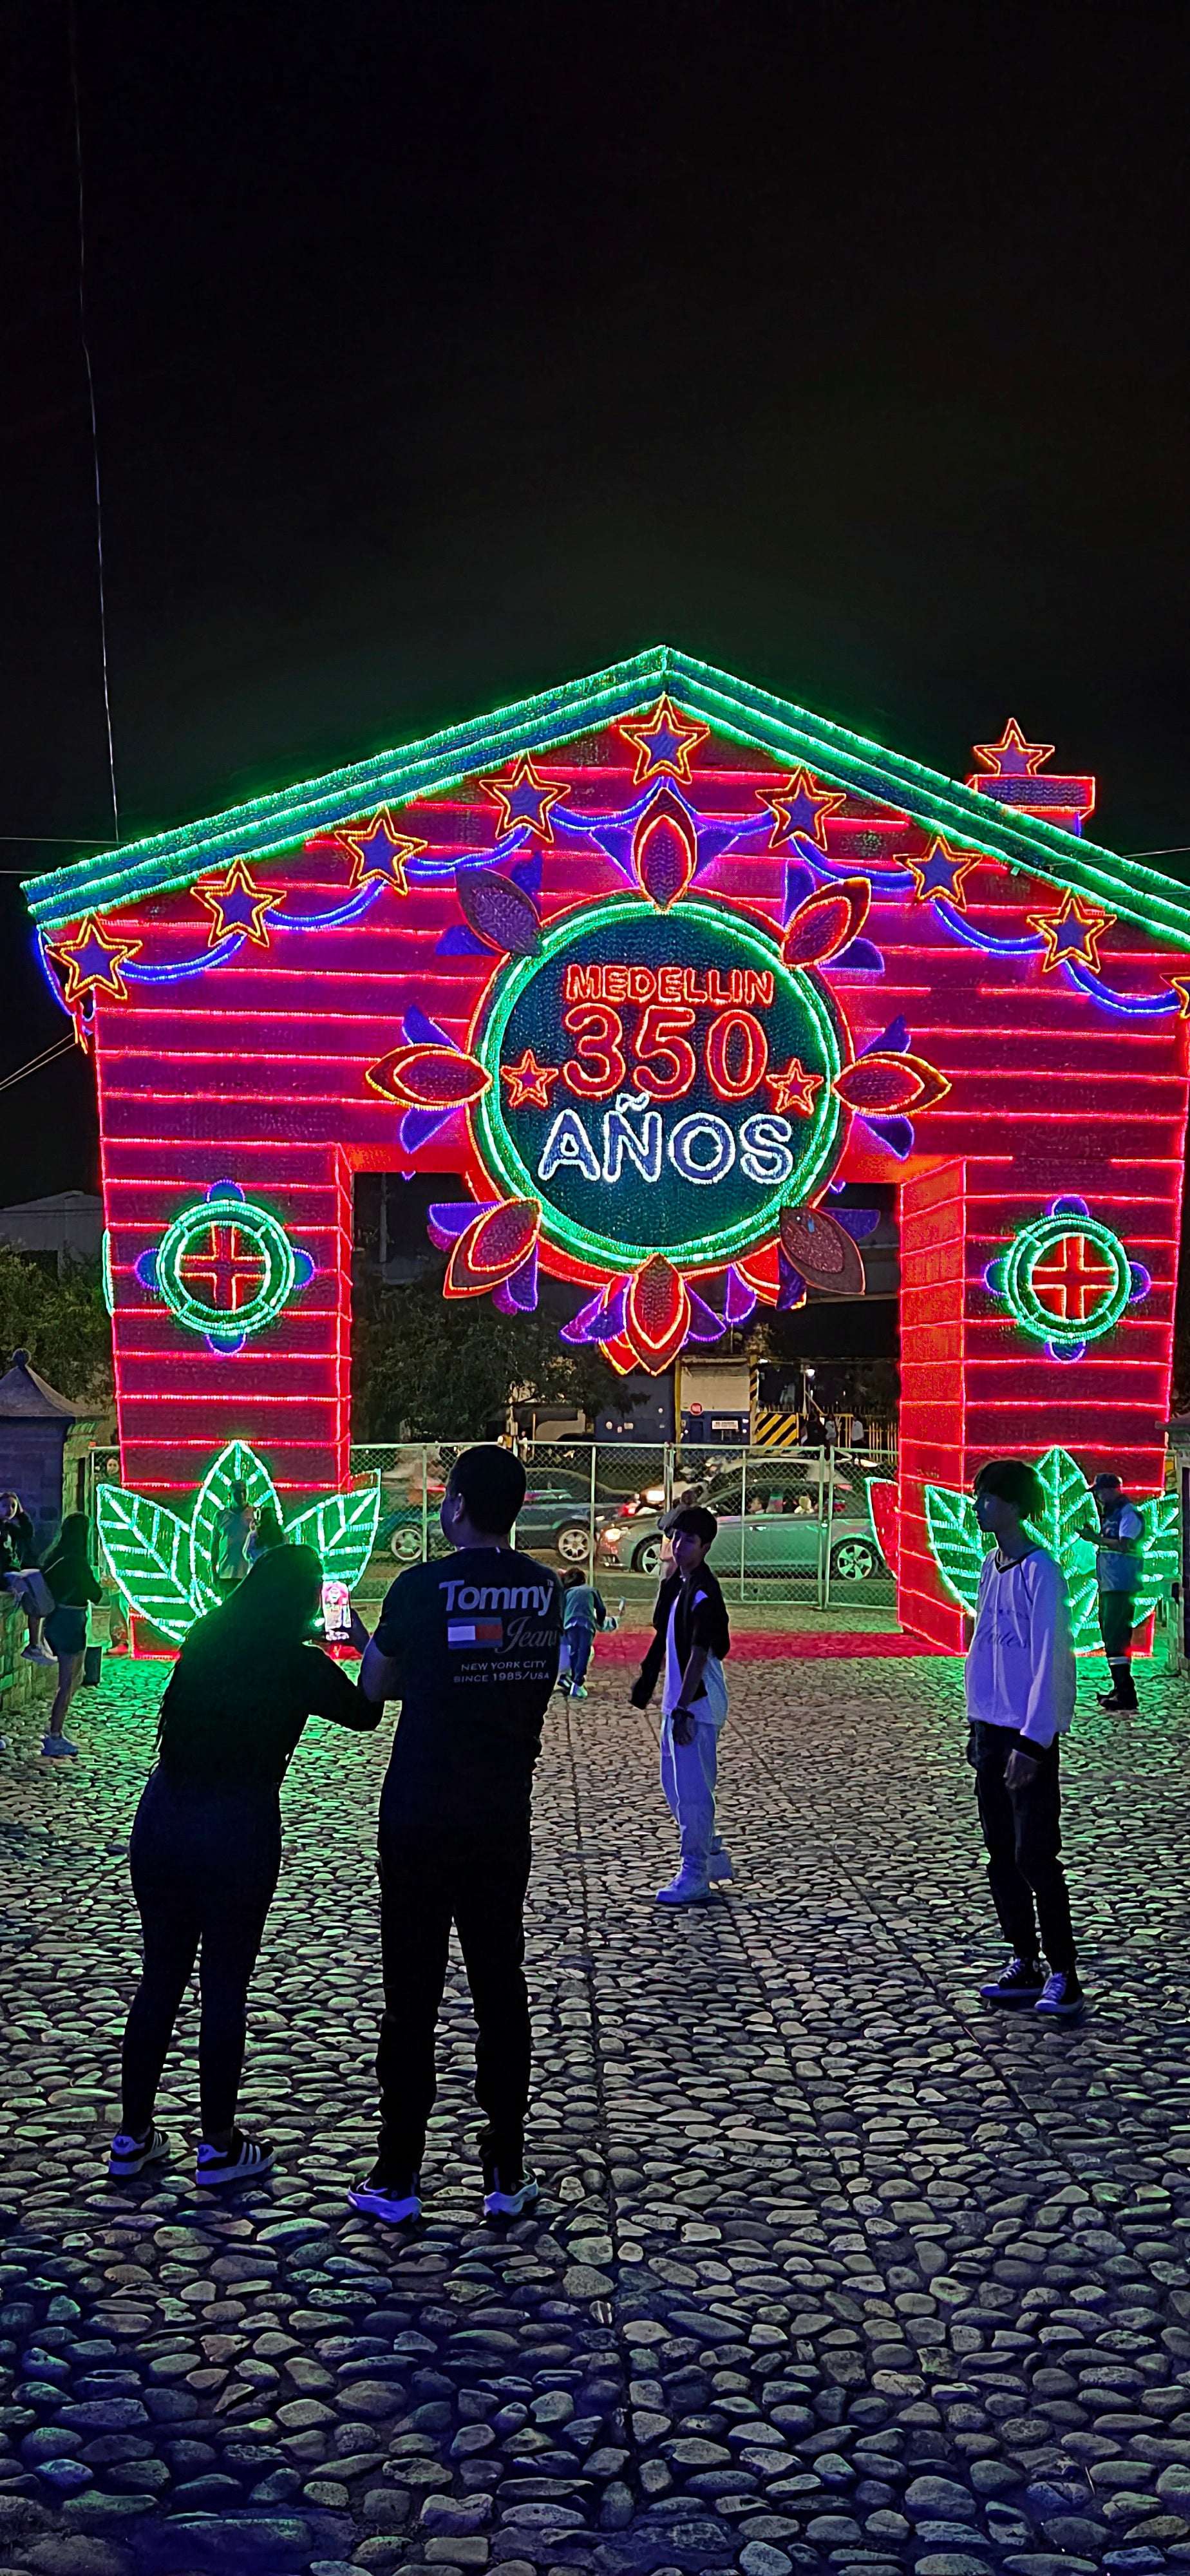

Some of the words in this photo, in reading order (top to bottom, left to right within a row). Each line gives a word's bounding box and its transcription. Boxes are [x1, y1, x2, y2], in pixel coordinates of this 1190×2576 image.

[566, 964, 774, 1005] MEDELLIN
[562, 1002, 768, 1099] 350
[538, 1092, 793, 1184] AÑOS
[439, 1580, 554, 1616] Tommy
[453, 1674, 489, 1683] SINCE
[461, 1662, 487, 1671] NEW
[491, 1661, 520, 1669] YORK
